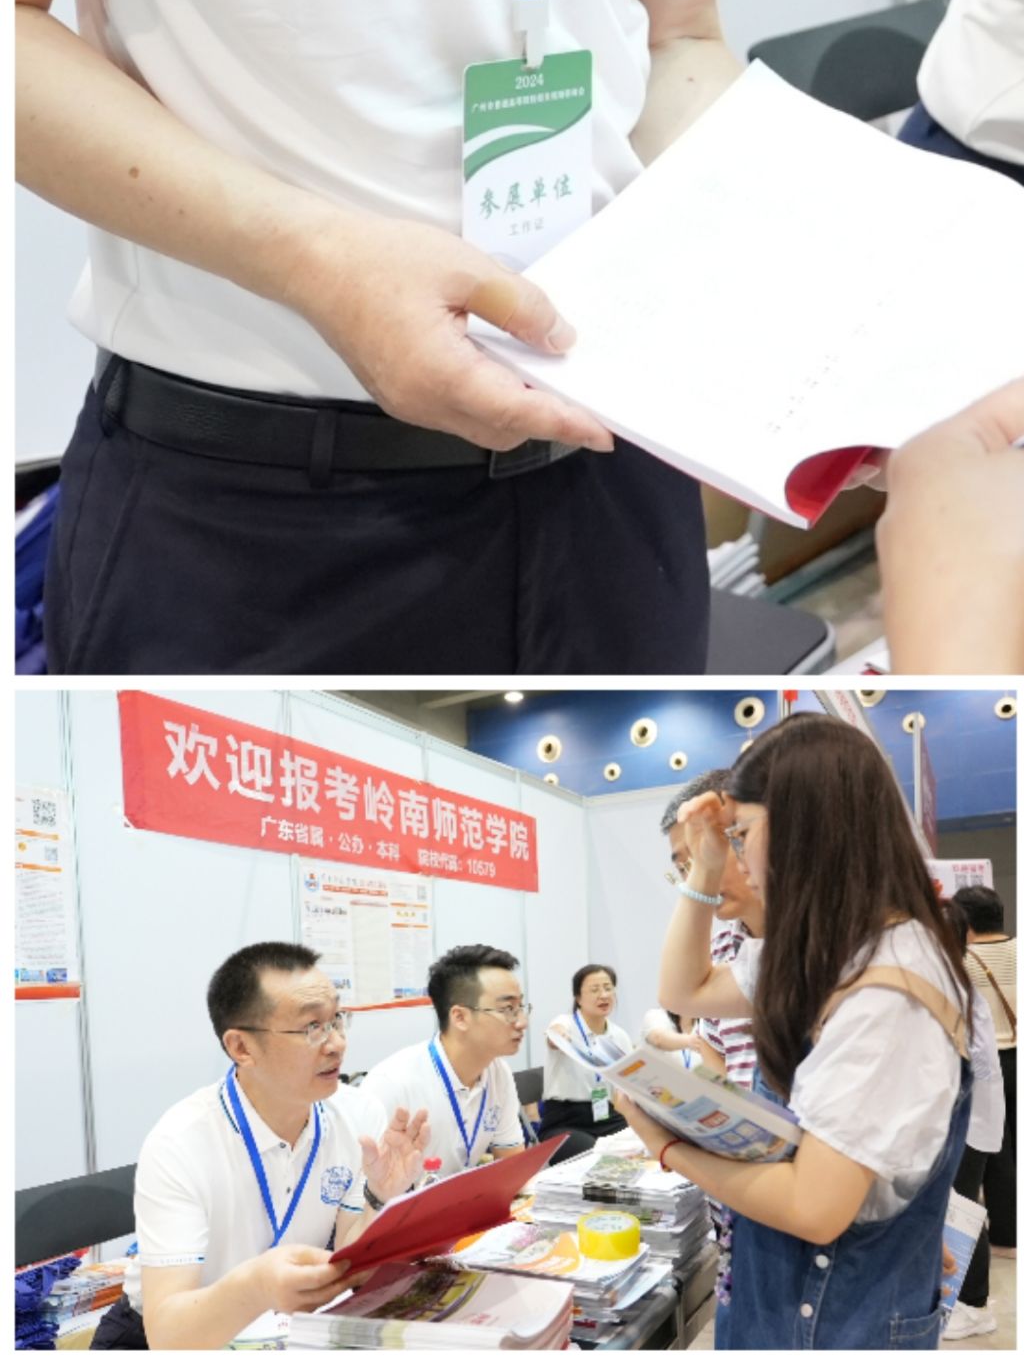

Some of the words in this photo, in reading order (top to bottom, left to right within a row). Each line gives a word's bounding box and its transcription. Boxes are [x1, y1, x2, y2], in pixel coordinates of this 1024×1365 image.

[515, 73, 544, 90] 2024
[479, 174, 573, 220] 参展单位
[163, 719, 530, 861] 欢迎报考岭南师范学院
